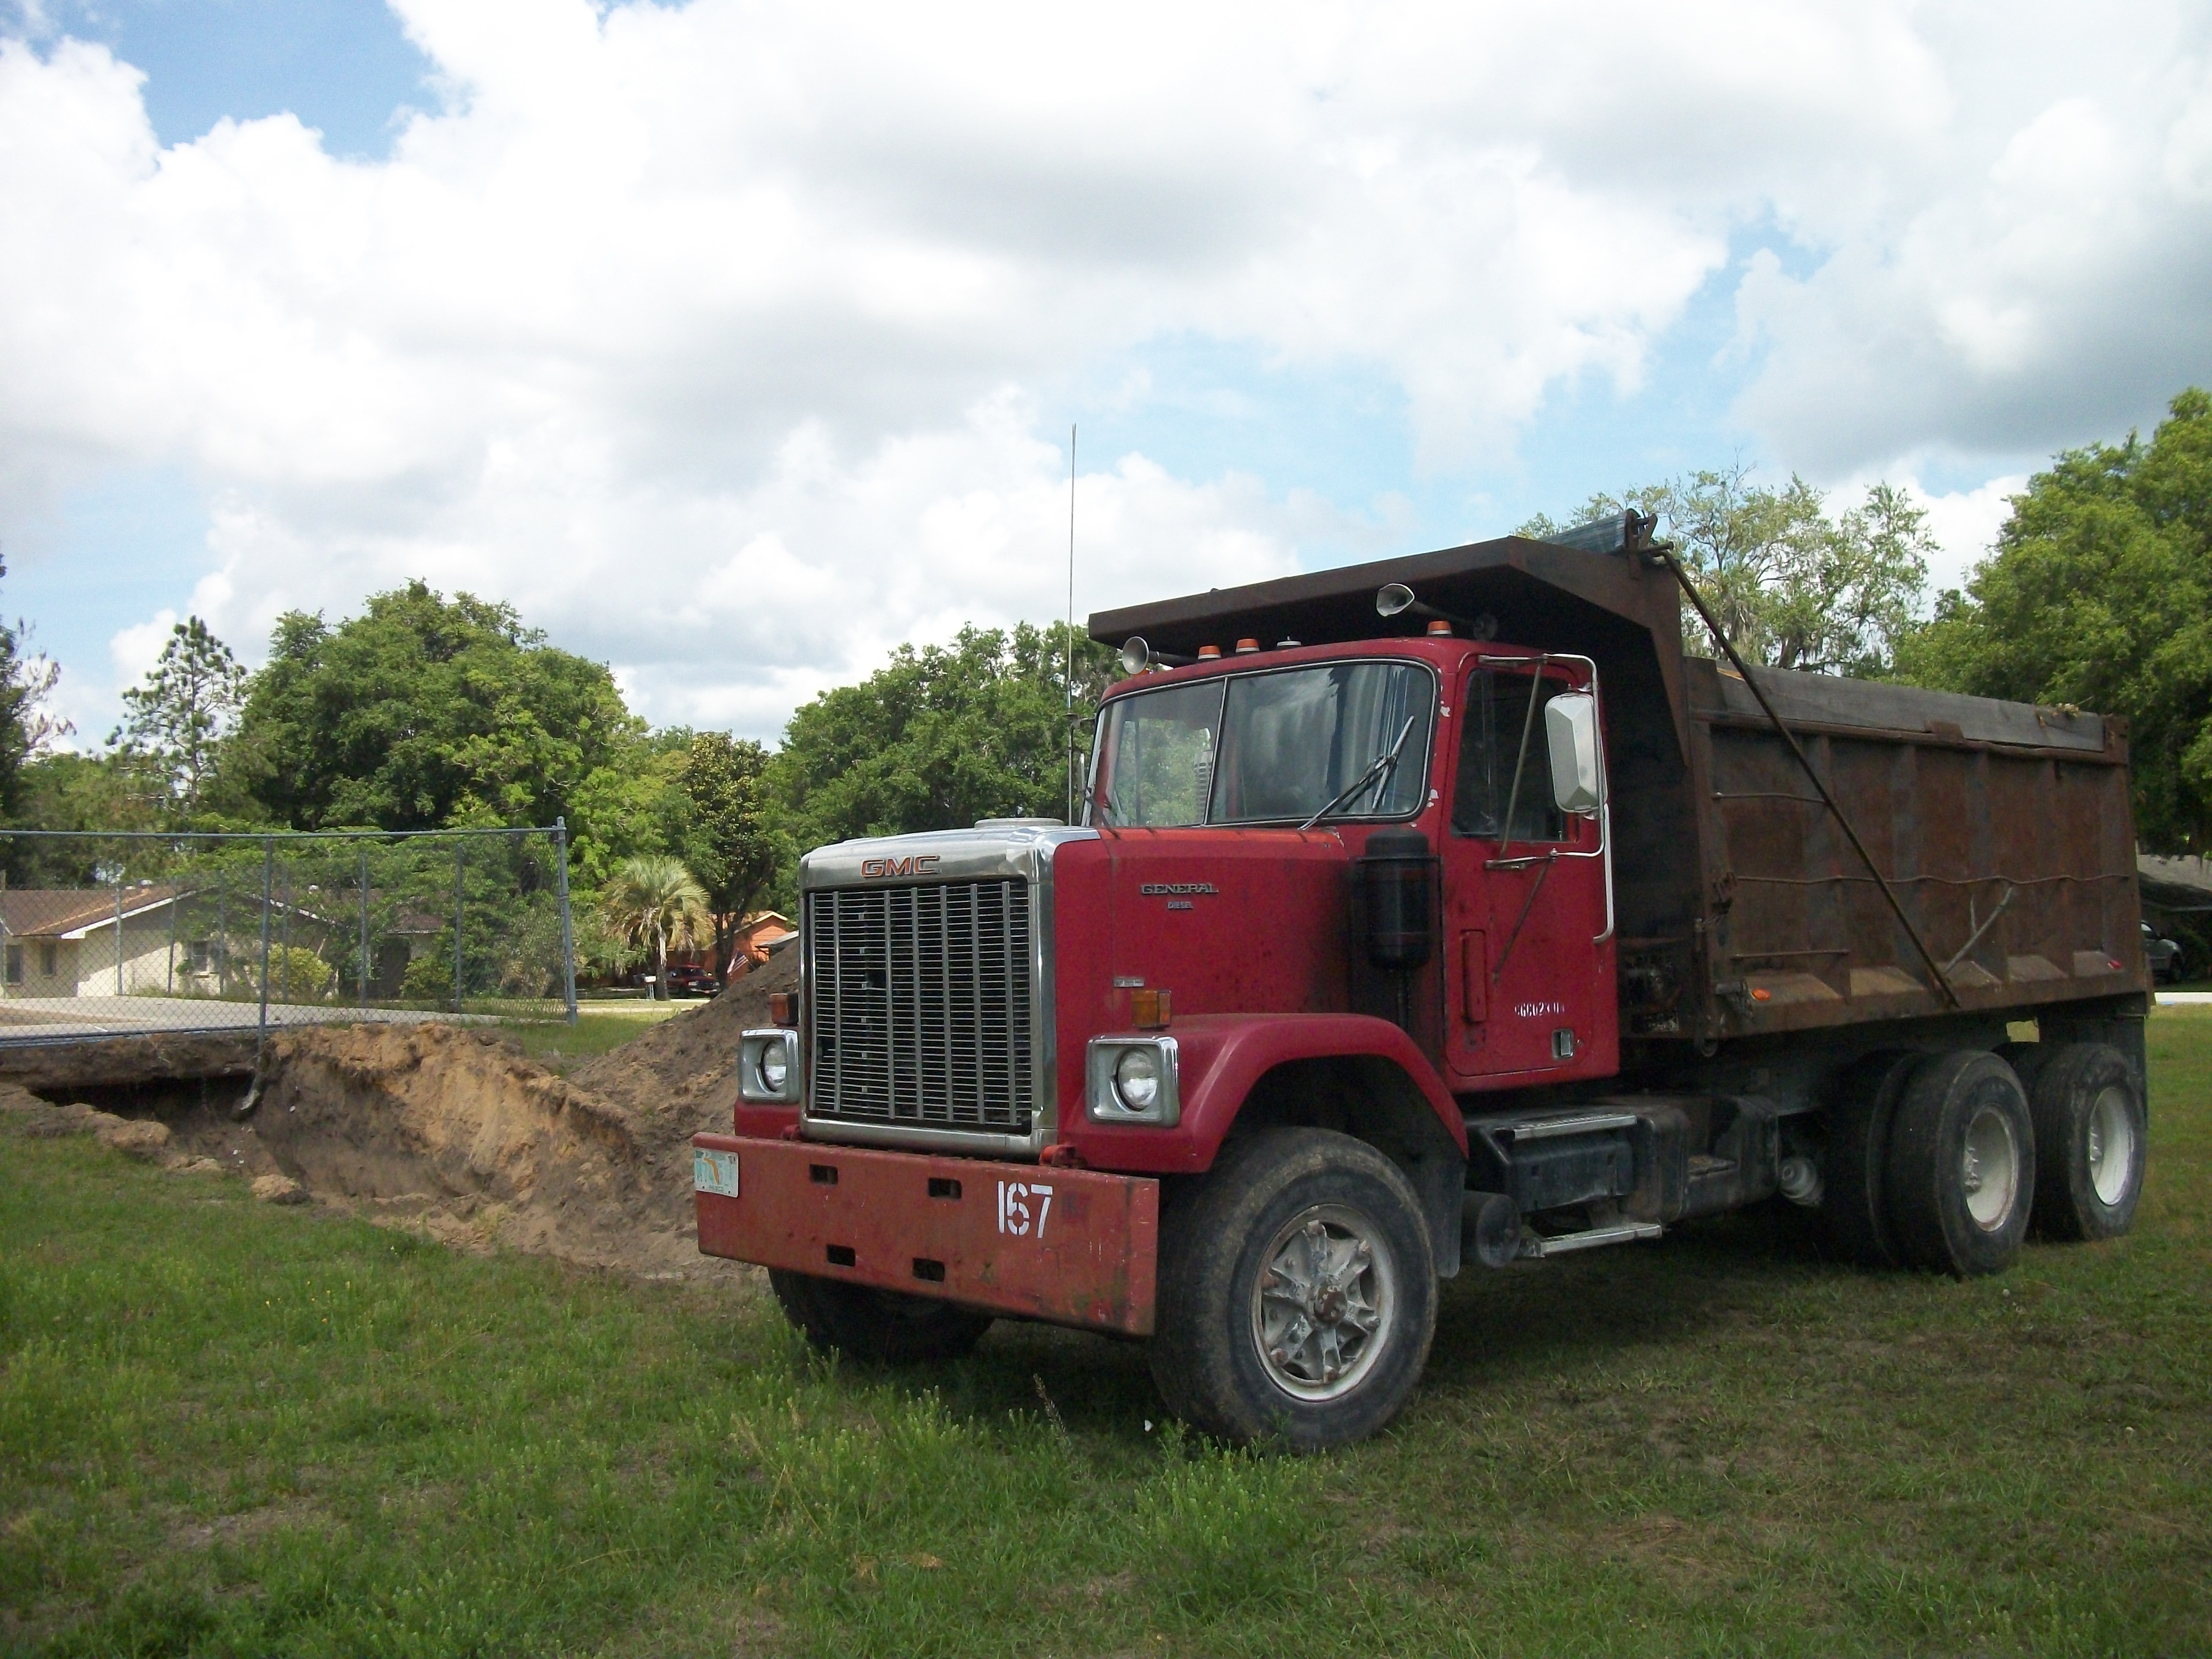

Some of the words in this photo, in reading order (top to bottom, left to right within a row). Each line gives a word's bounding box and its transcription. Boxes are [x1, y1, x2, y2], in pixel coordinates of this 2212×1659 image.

[860, 854, 941, 878] GMC
[1141, 883, 1219, 894] GENERAL
[1167, 901, 1194, 910] DIESEL
[998, 1181, 1053, 1239] 167
